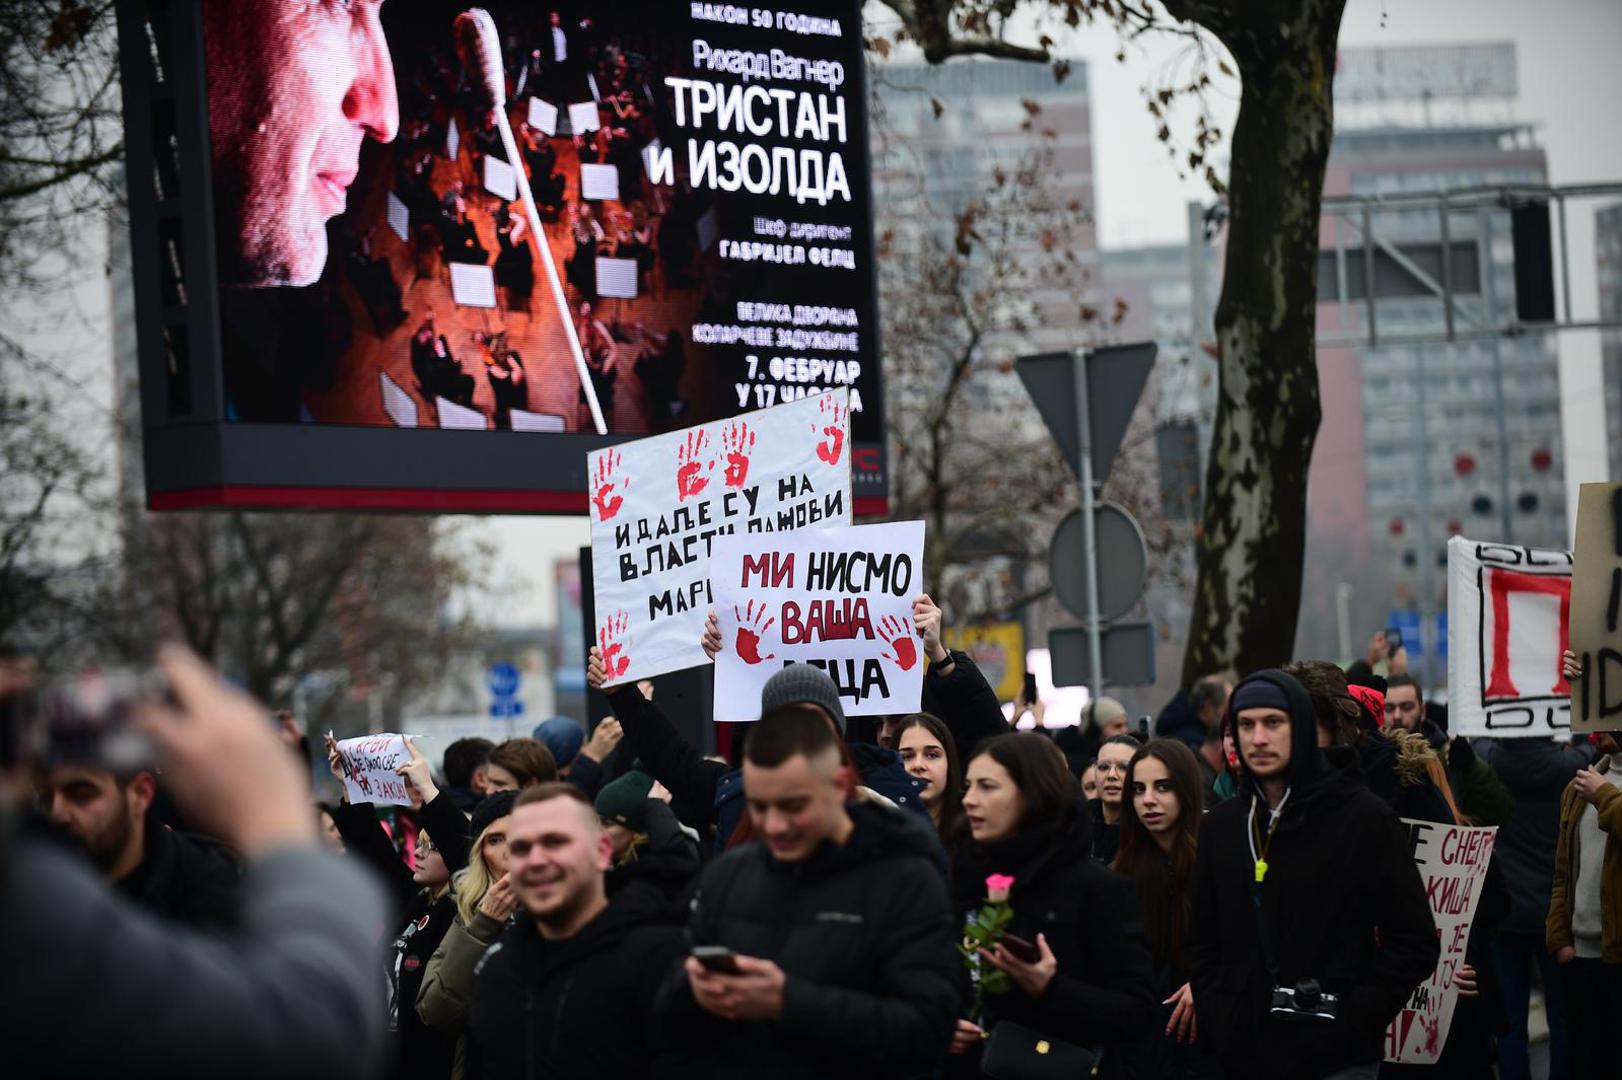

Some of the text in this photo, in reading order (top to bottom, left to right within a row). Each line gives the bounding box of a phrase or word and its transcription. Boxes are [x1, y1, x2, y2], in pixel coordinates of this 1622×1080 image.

[692, 39, 845, 92] Рихард Вагнер
[664, 77, 847, 143] ТРИСТАН
[688, 138, 851, 206] ИЗОЛДА
[745, 355, 861, 384] 7. ФЕБРУАР
[735, 382, 750, 408] У
[754, 384, 776, 409] 17
[723, 486, 759, 517] СУ
[778, 473, 814, 501] НА
[741, 551, 912, 596] МИ НИСМО
[781, 598, 875, 644] ВАША
[1427, 875, 1474, 914] КИША
